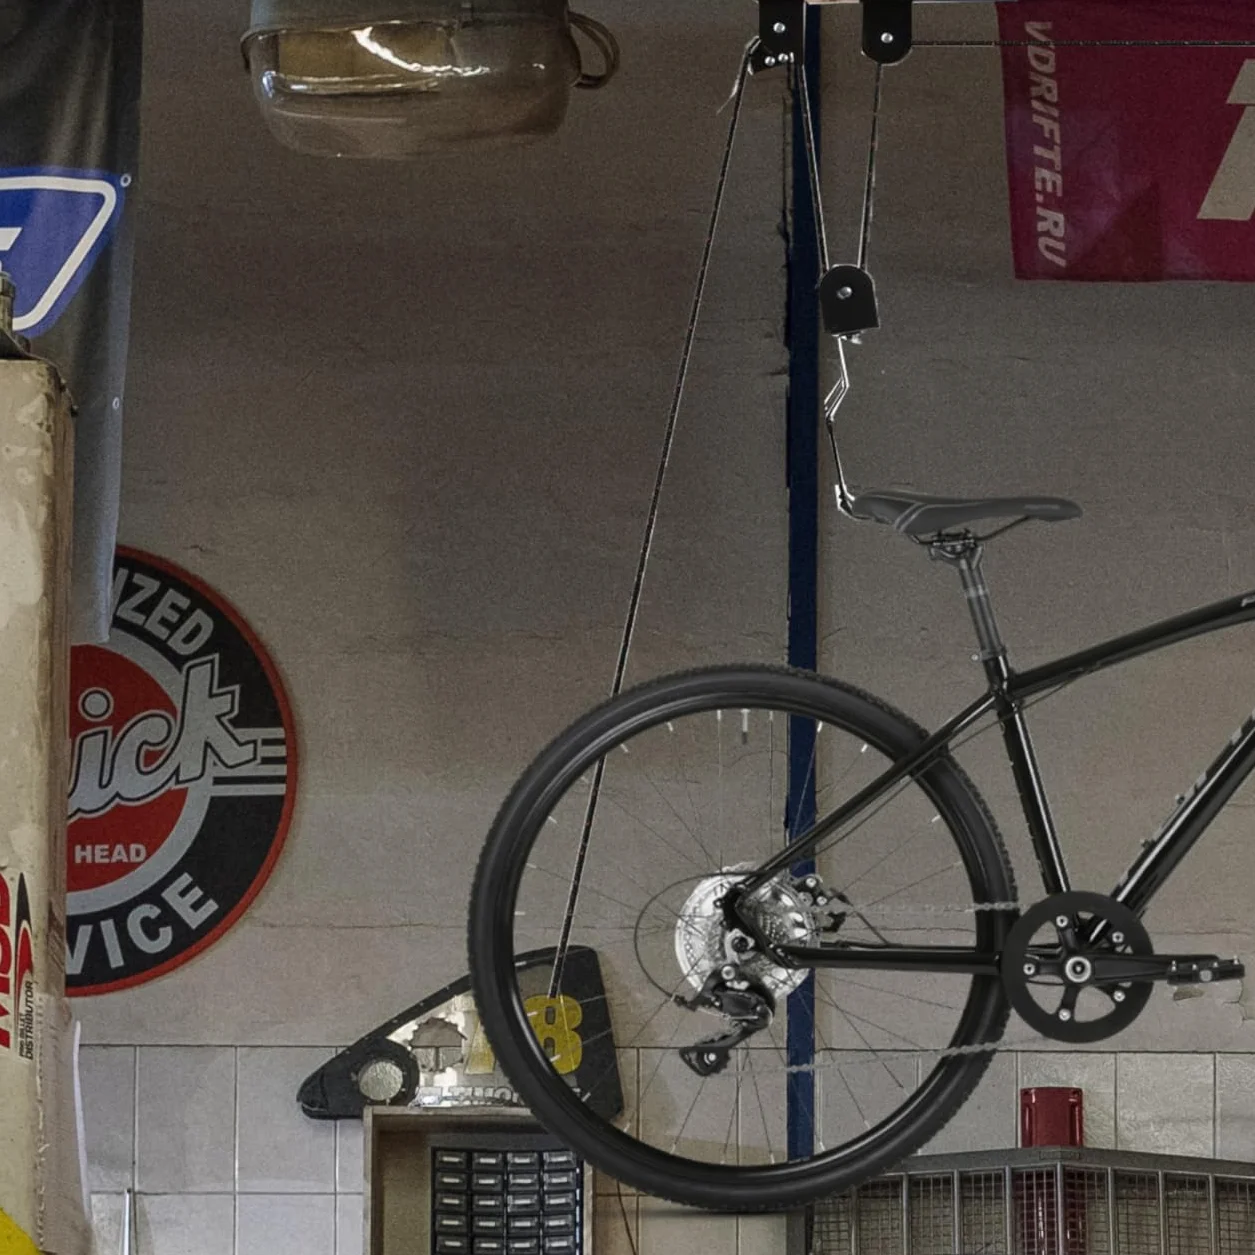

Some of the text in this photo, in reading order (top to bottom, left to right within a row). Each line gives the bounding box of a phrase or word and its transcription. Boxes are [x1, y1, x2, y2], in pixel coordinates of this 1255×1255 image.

[1024, 20, 1067, 268] VDRIFTE.RU
[74, 843, 147, 864] HEAD
[24, 981, 34, 1060] DISTRIBUTOR
